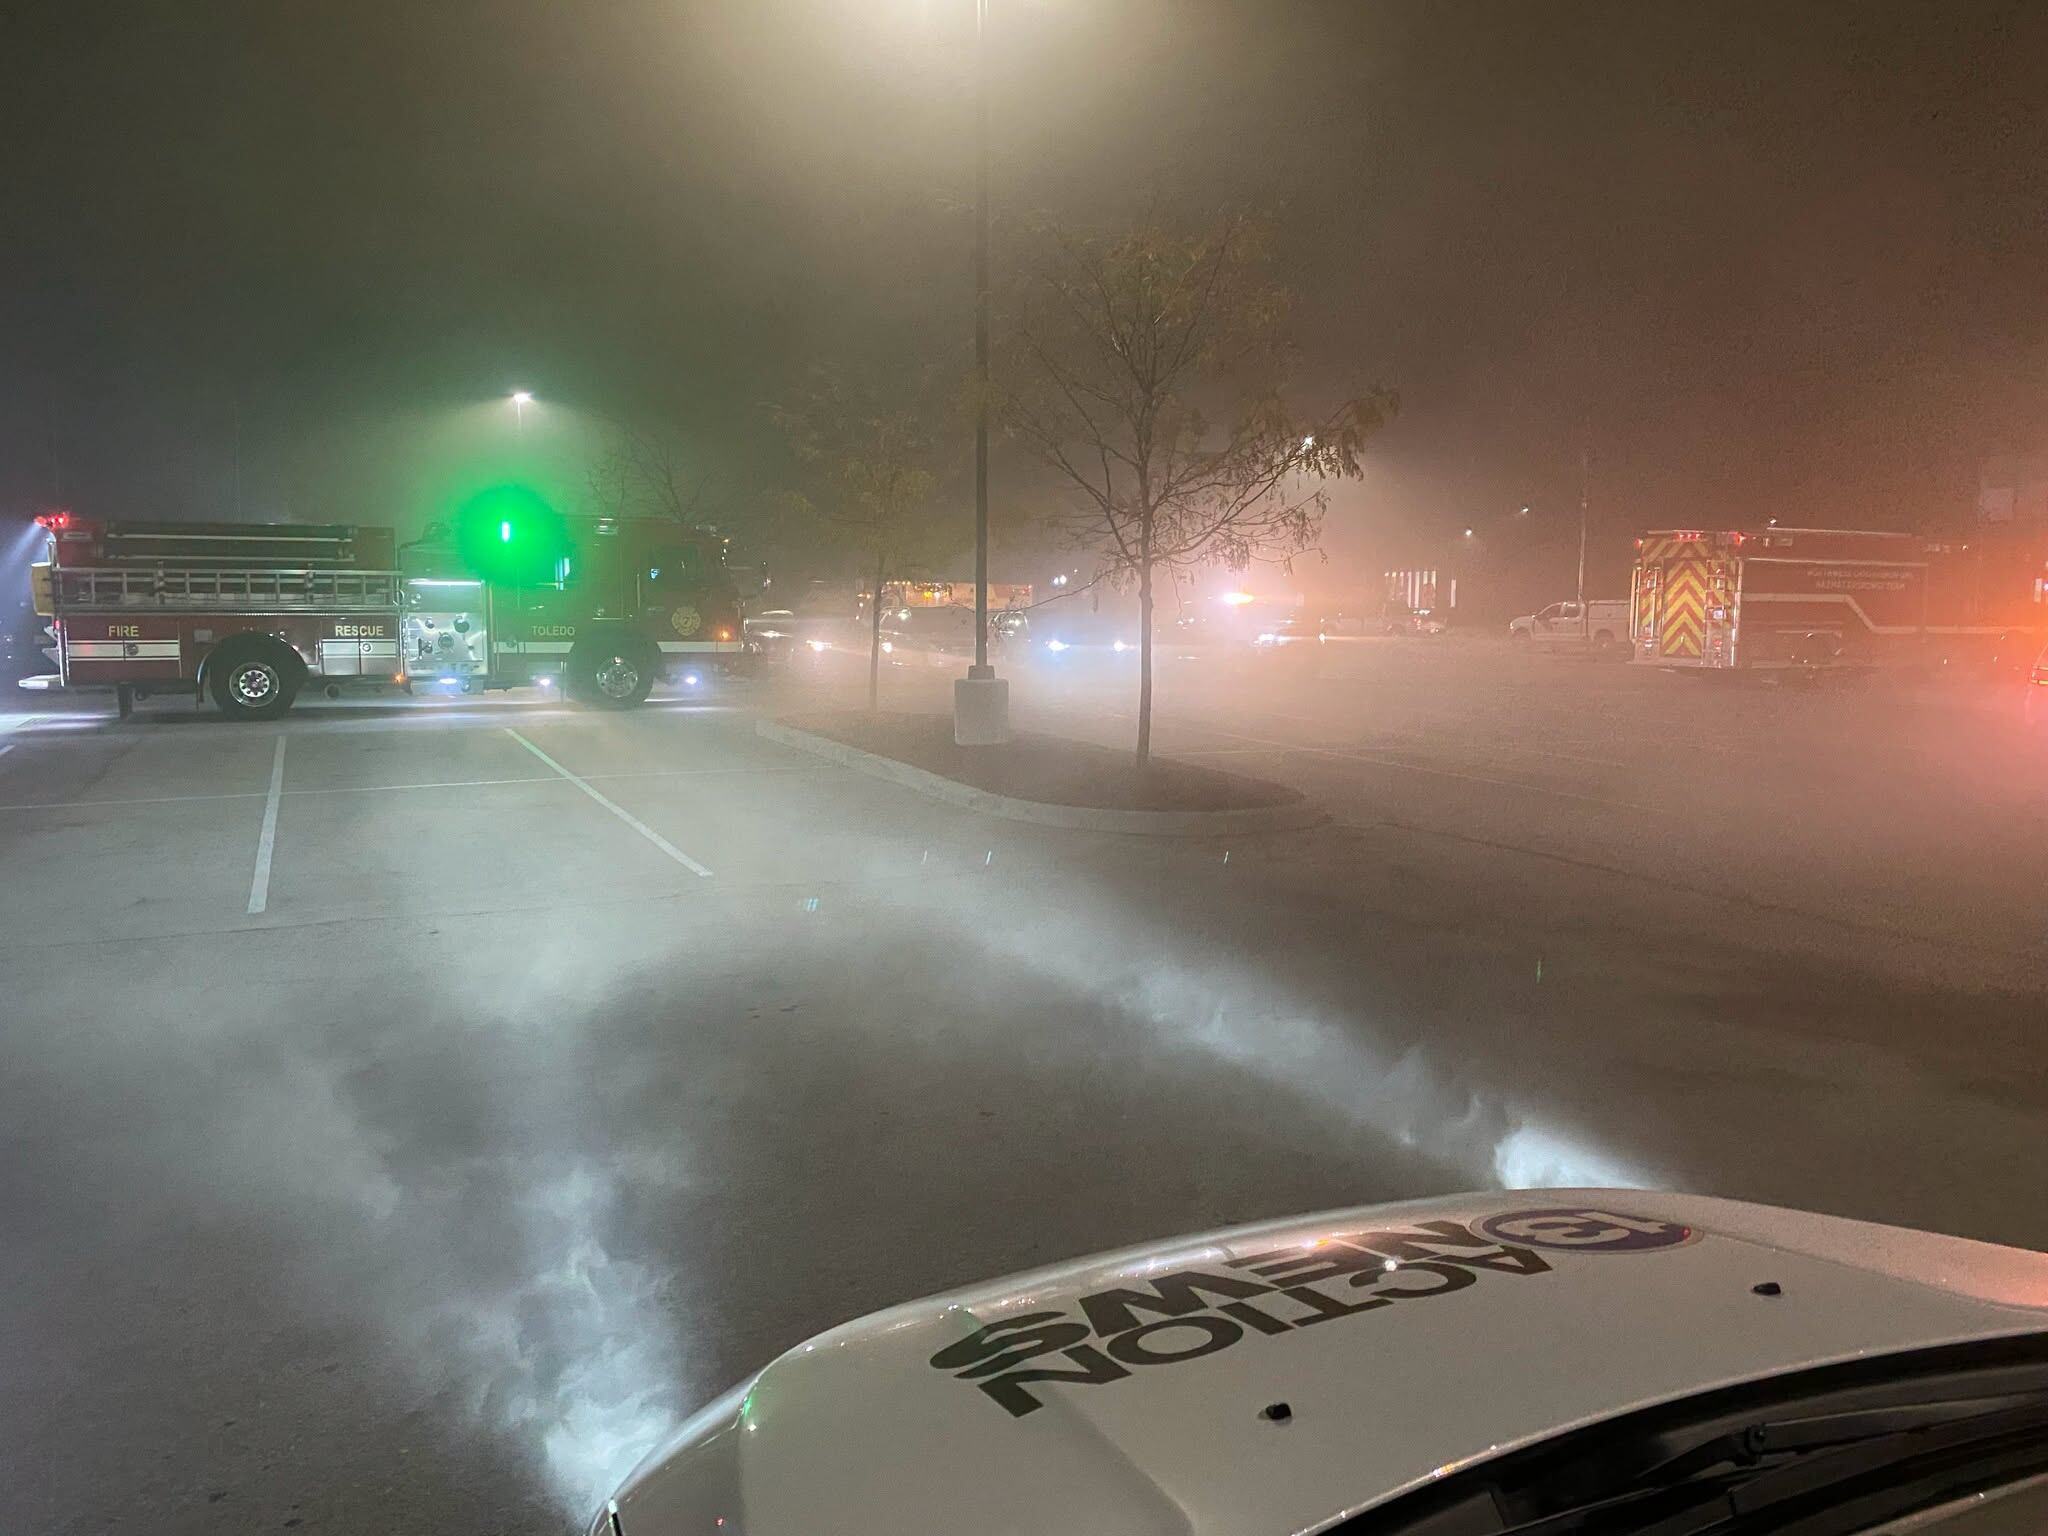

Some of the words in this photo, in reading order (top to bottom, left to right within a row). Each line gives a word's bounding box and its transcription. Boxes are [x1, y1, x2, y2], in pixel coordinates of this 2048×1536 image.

[108, 625, 139, 637] FIRE
[335, 625, 384, 637] RESCUE
[532, 625, 575, 636] TOLEDO
[1496, 1211, 1668, 1245] 13
[930, 1220, 1498, 1379] NEWS
[978, 1245, 1553, 1418] ACTION
